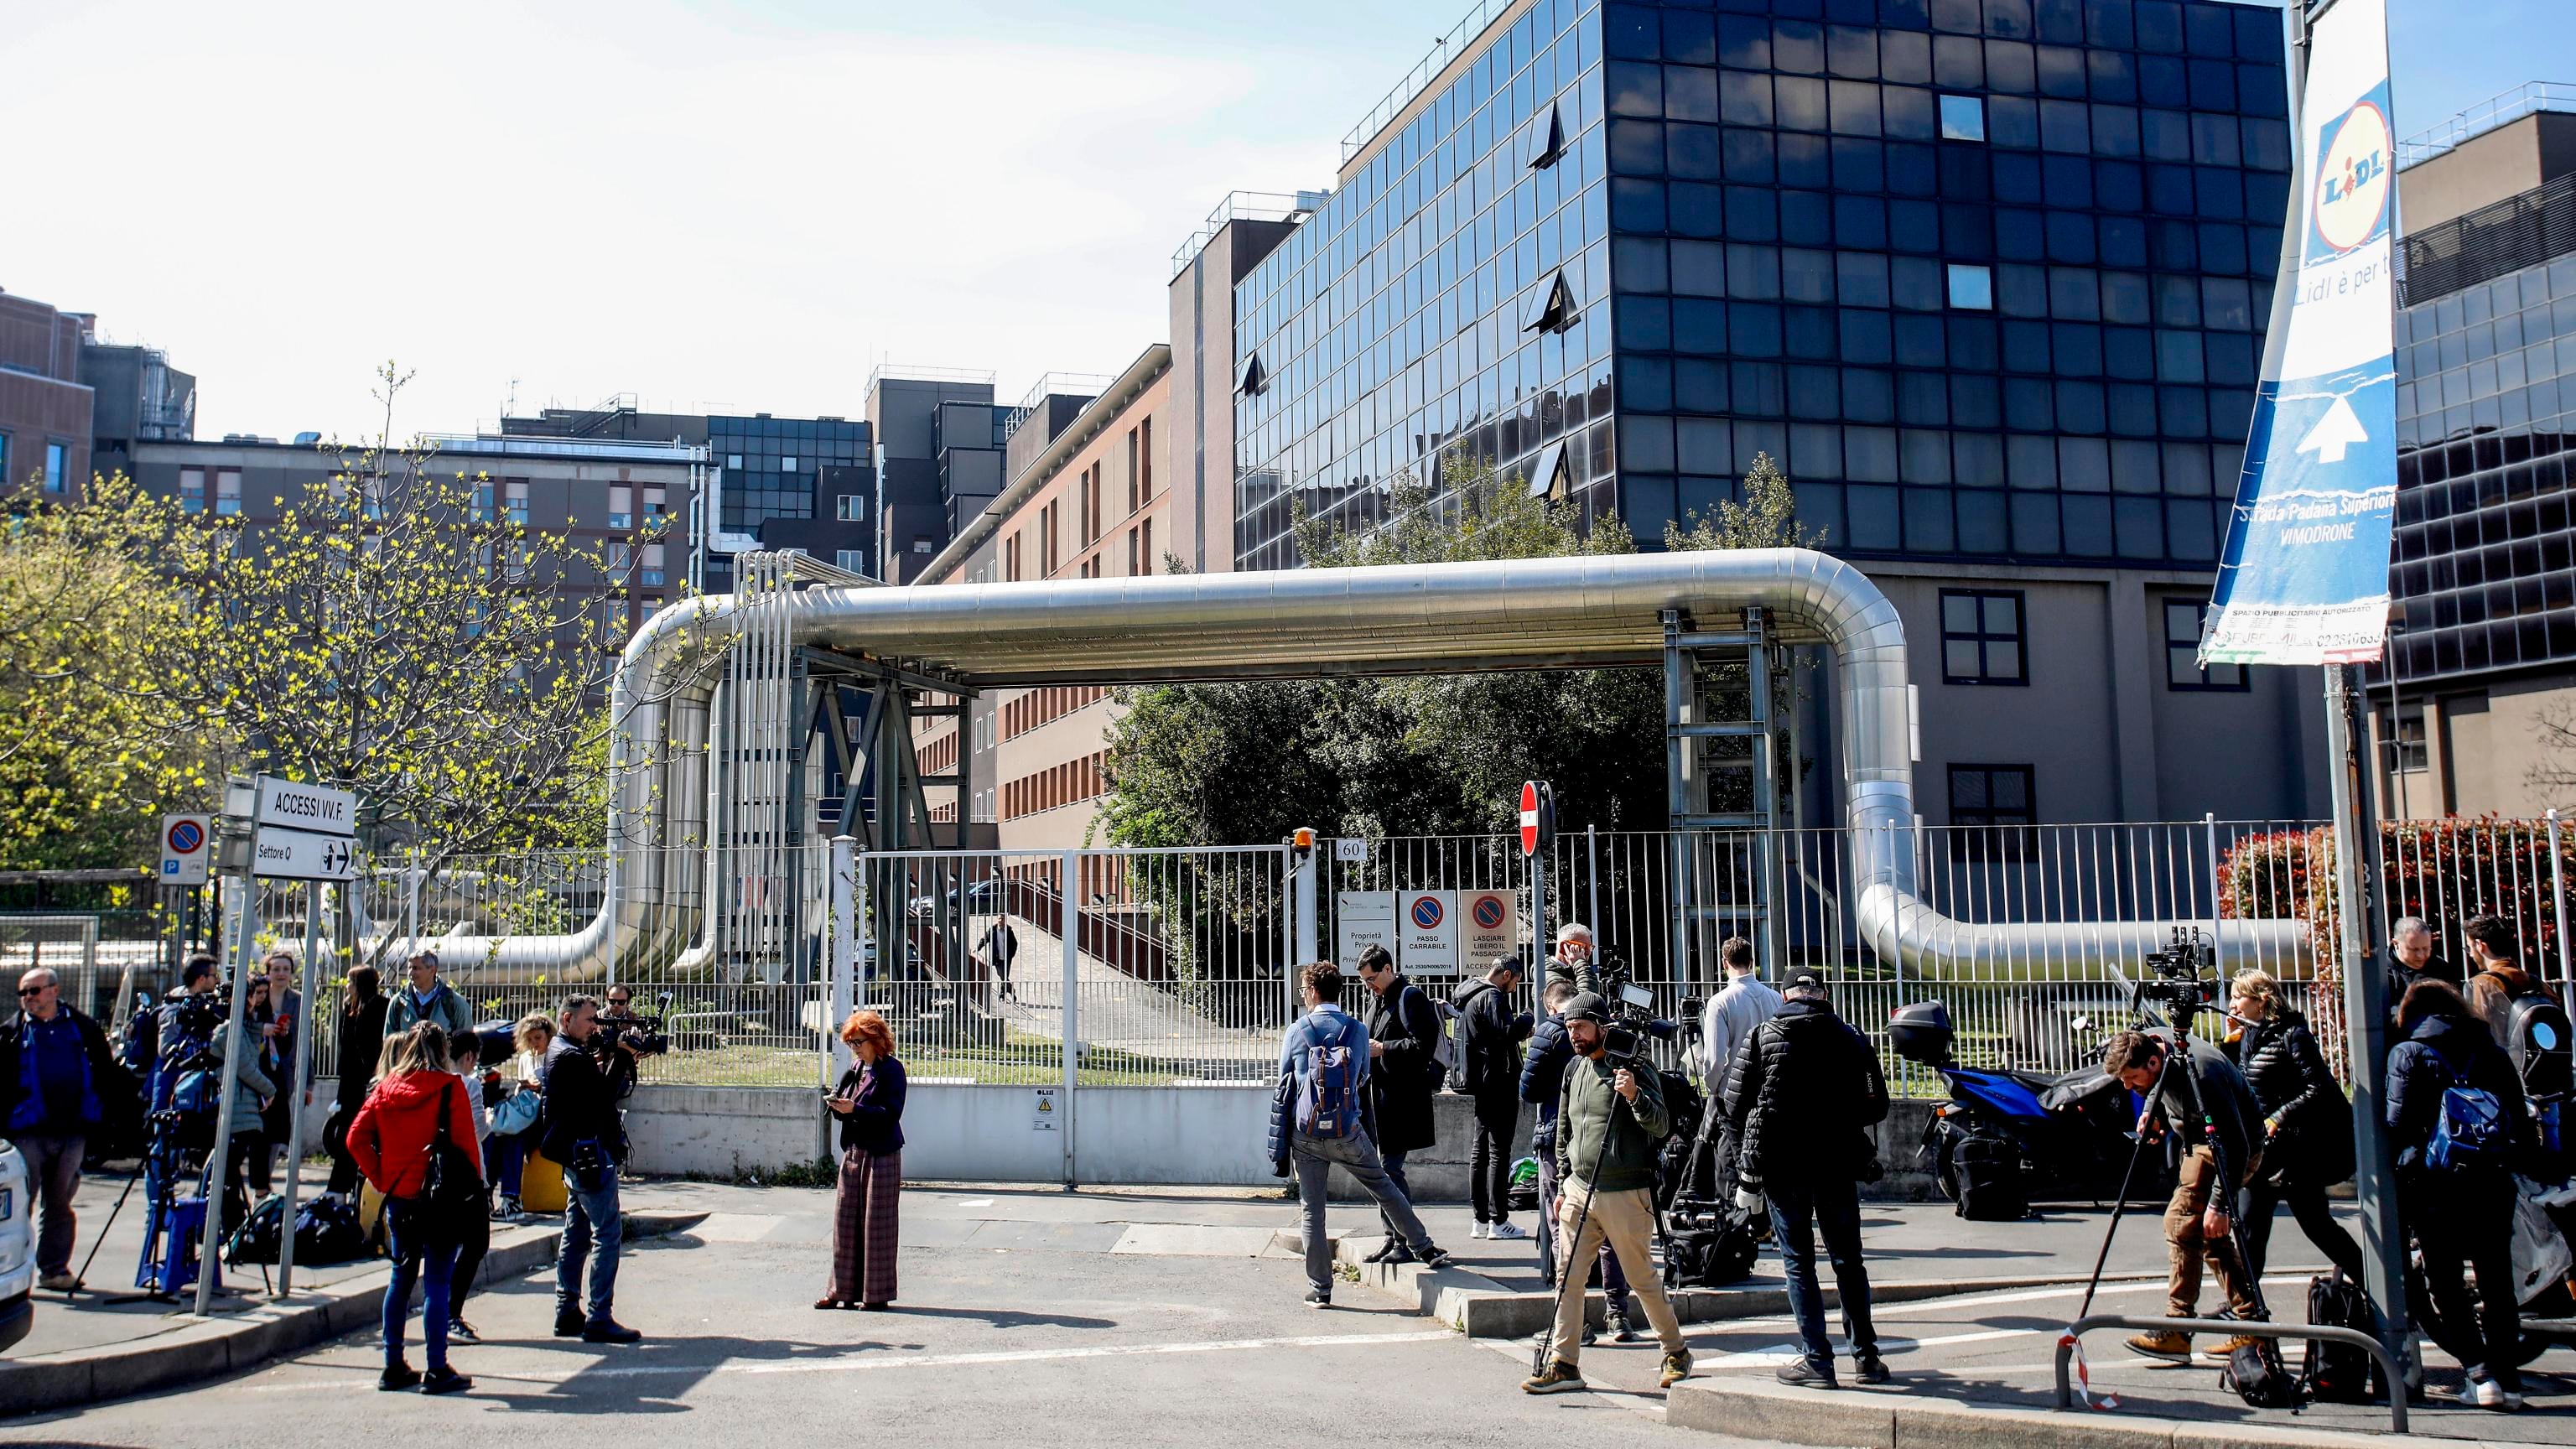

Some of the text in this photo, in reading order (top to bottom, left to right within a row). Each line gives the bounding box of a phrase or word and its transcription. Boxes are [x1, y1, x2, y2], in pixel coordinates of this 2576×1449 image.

[2294, 276, 2331, 306] Lidl
[2338, 271, 2348, 294] è
[2354, 261, 2377, 294] per
[2239, 503, 2284, 523] Strada
[2288, 502, 2337, 521] Padana
[2281, 522, 2355, 544] VIMODRONE
[2323, 606, 2371, 615] AUTORIZZATO
[274, 792, 319, 817] ACCESSI
[258, 844, 291, 860] Settore Q
[1343, 843, 1359, 856] 60
[1350, 932, 1382, 941] Proprietà
